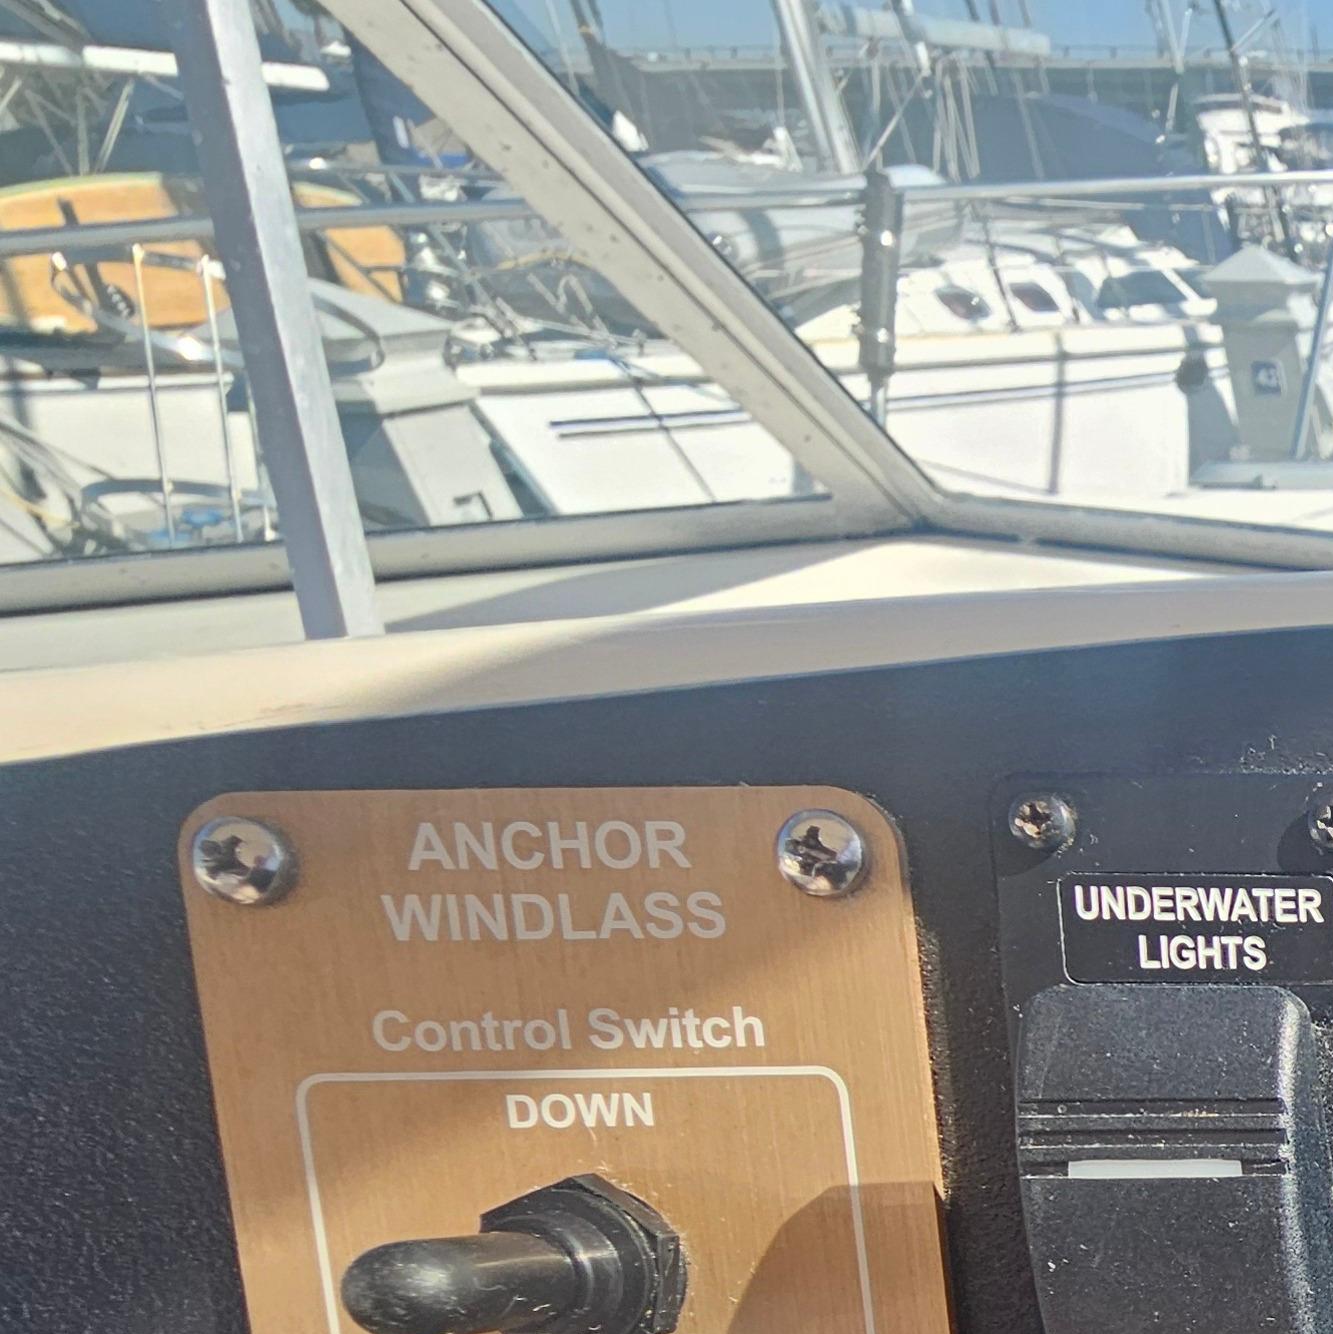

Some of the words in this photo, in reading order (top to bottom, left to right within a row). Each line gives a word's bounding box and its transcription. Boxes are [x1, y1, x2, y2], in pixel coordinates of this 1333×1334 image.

[408, 819, 691, 871] ANCHOR
[382, 890, 727, 942] WINDLASS
[1075, 885, 1324, 924] UNDERWATER
[1138, 935, 1267, 971] LIGHTS
[373, 1008, 571, 1053] Control
[589, 1005, 765, 1050] Switch
[507, 1092, 655, 1130] DOWN
